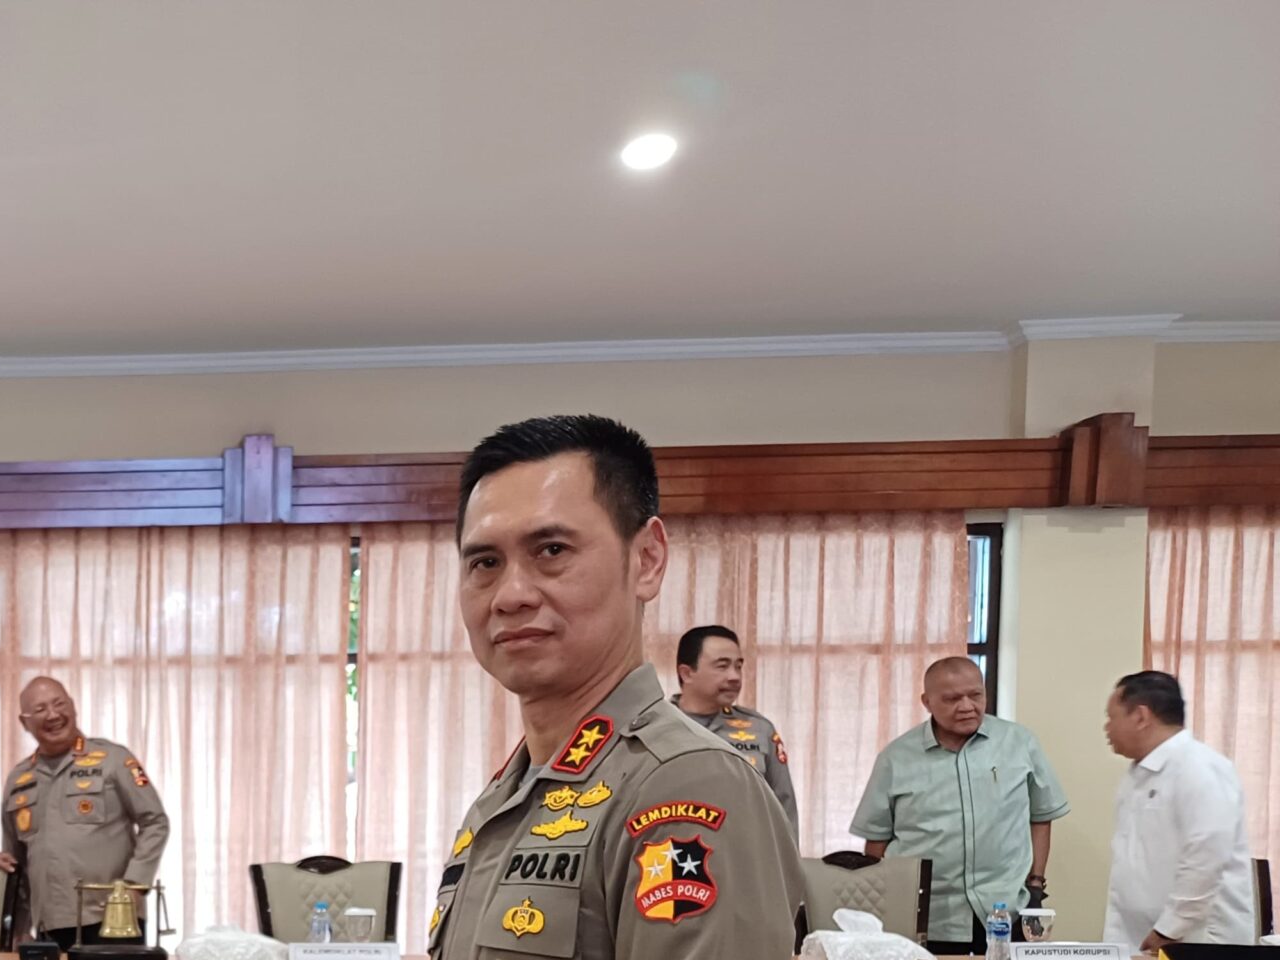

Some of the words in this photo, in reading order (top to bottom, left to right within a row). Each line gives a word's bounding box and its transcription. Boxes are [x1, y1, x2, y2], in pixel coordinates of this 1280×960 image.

[70, 768, 103, 779] POLRI
[631, 803, 719, 830] LEMDIKLAT
[504, 852, 581, 882] POLRI
[641, 886, 674, 908] MABES
[677, 884, 711, 901] POLRI
[1073, 948, 1110, 956] KORUPSI
